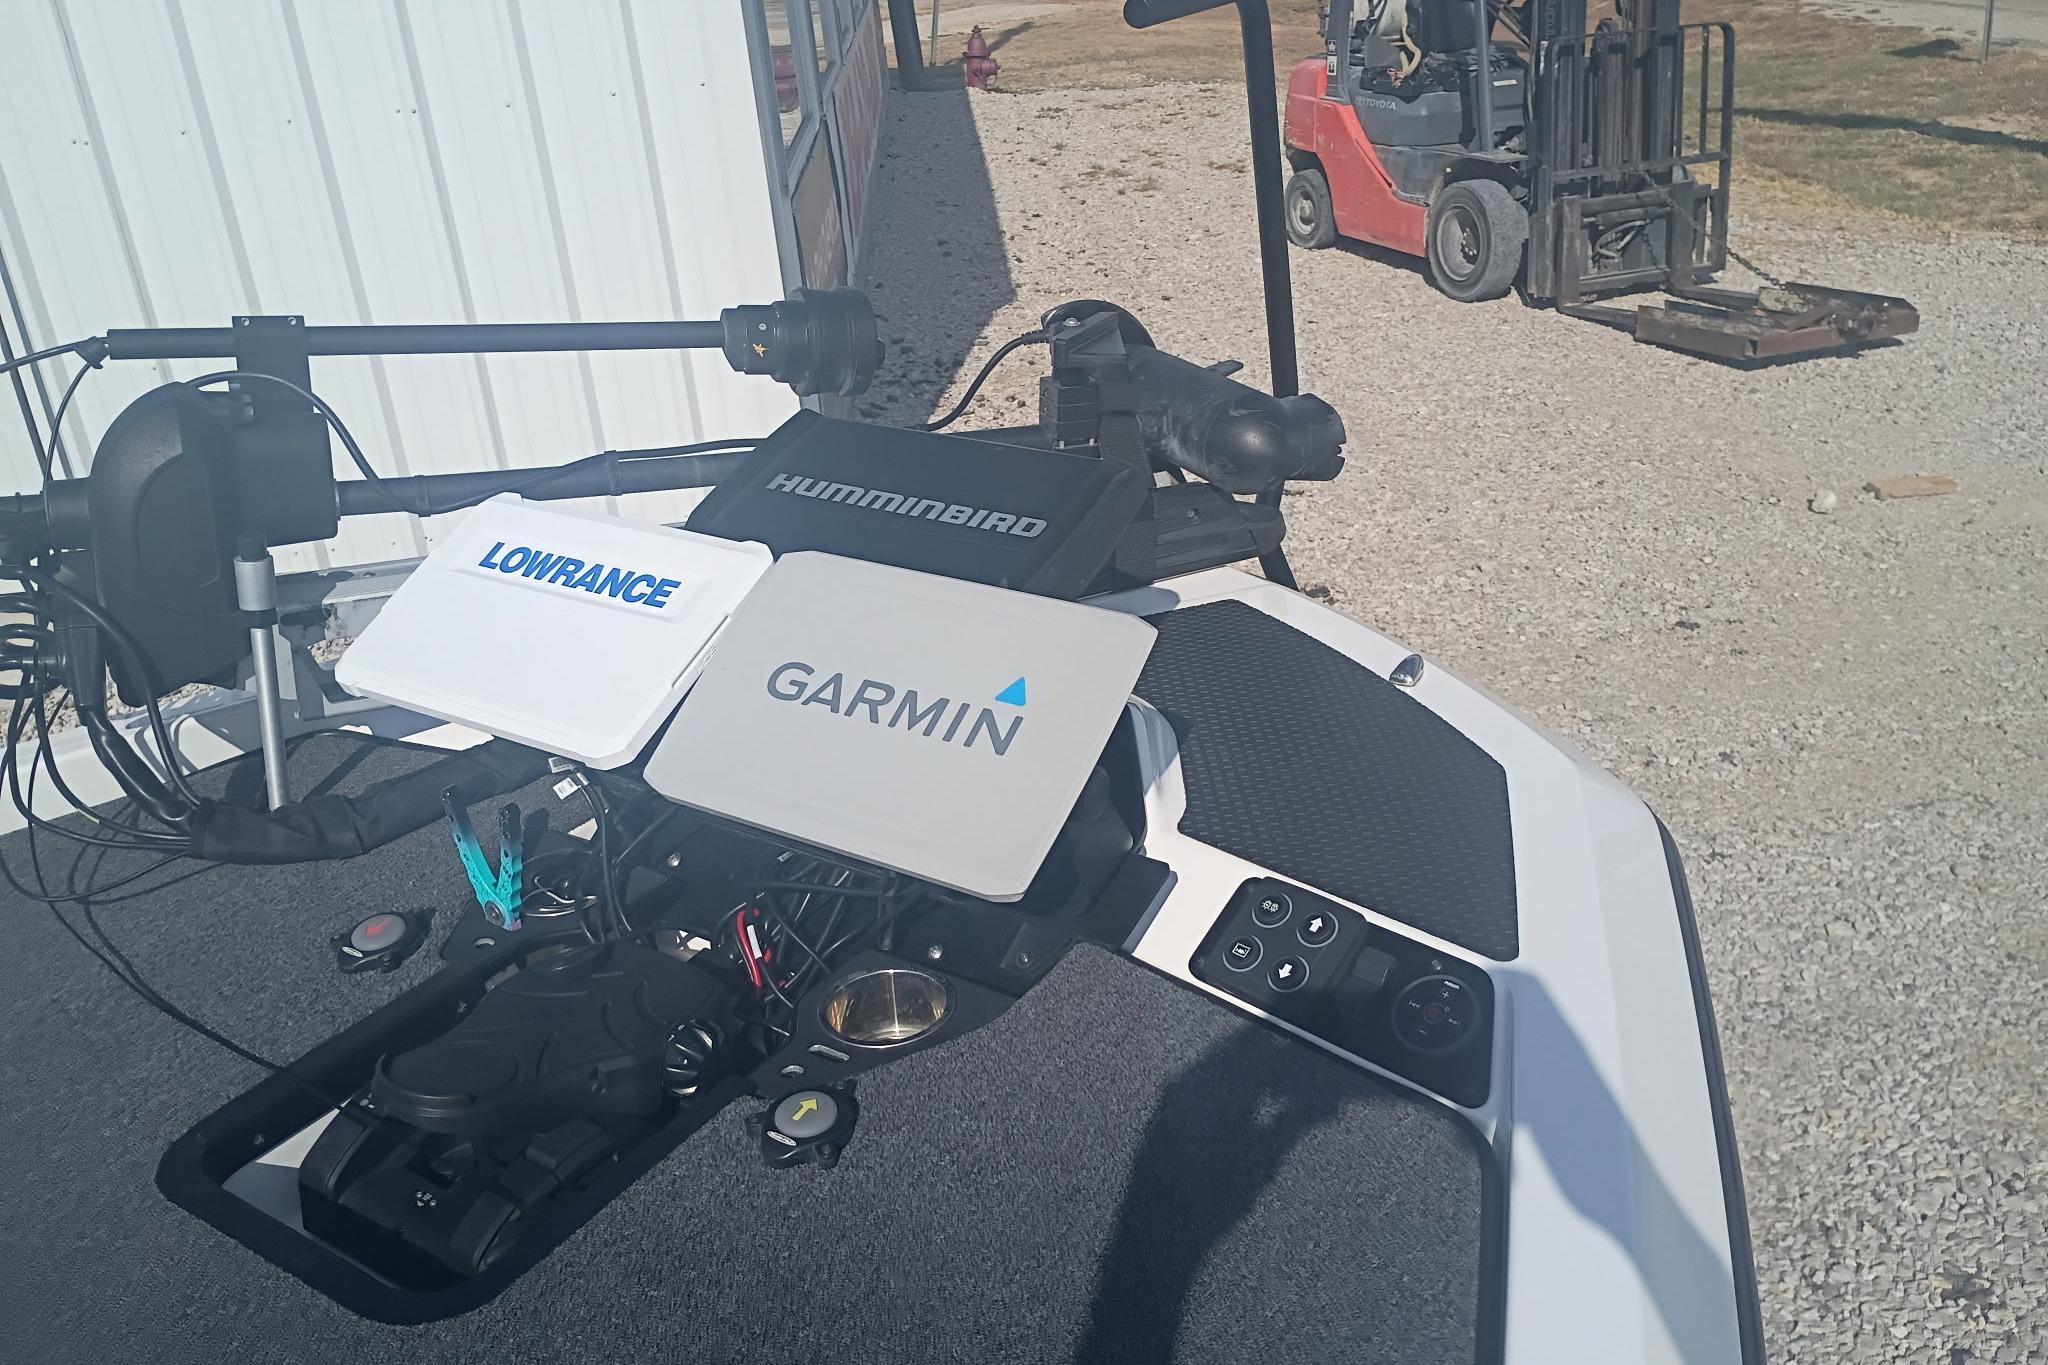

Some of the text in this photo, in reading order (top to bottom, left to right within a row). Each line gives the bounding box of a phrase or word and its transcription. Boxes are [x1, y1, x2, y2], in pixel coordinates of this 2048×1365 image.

[1365, 98, 1397, 111] TOYOTA
[766, 473, 1048, 538] HUMMINBIRD
[478, 541, 682, 609] LOWRANCE
[767, 661, 1024, 756] GARMIN
